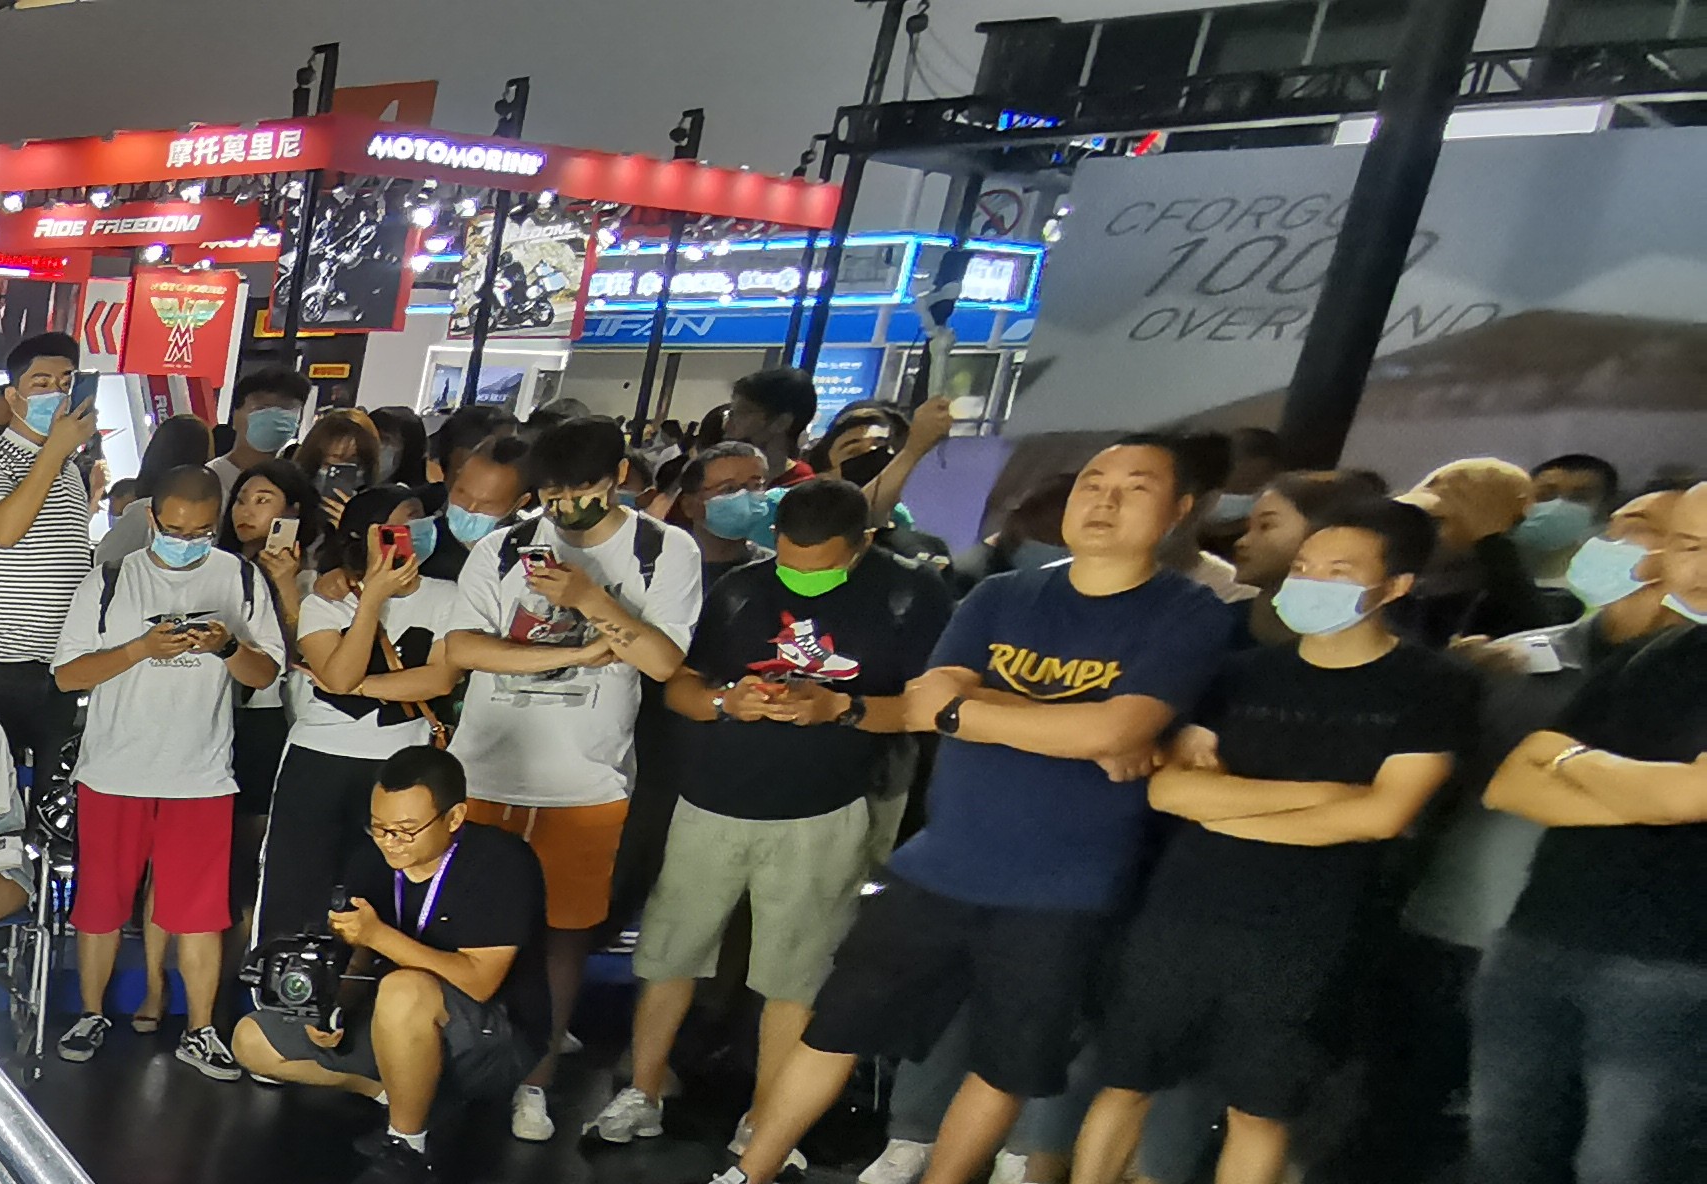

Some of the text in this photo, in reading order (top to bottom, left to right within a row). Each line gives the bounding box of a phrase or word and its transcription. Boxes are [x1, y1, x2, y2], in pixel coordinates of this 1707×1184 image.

[167, 129, 303, 167] 摩托莫里尼
[34, 213, 202, 238] RIDE FREEDOM
[583, 315, 716, 338] IFAN
[1127, 302, 1502, 342] OVERND
